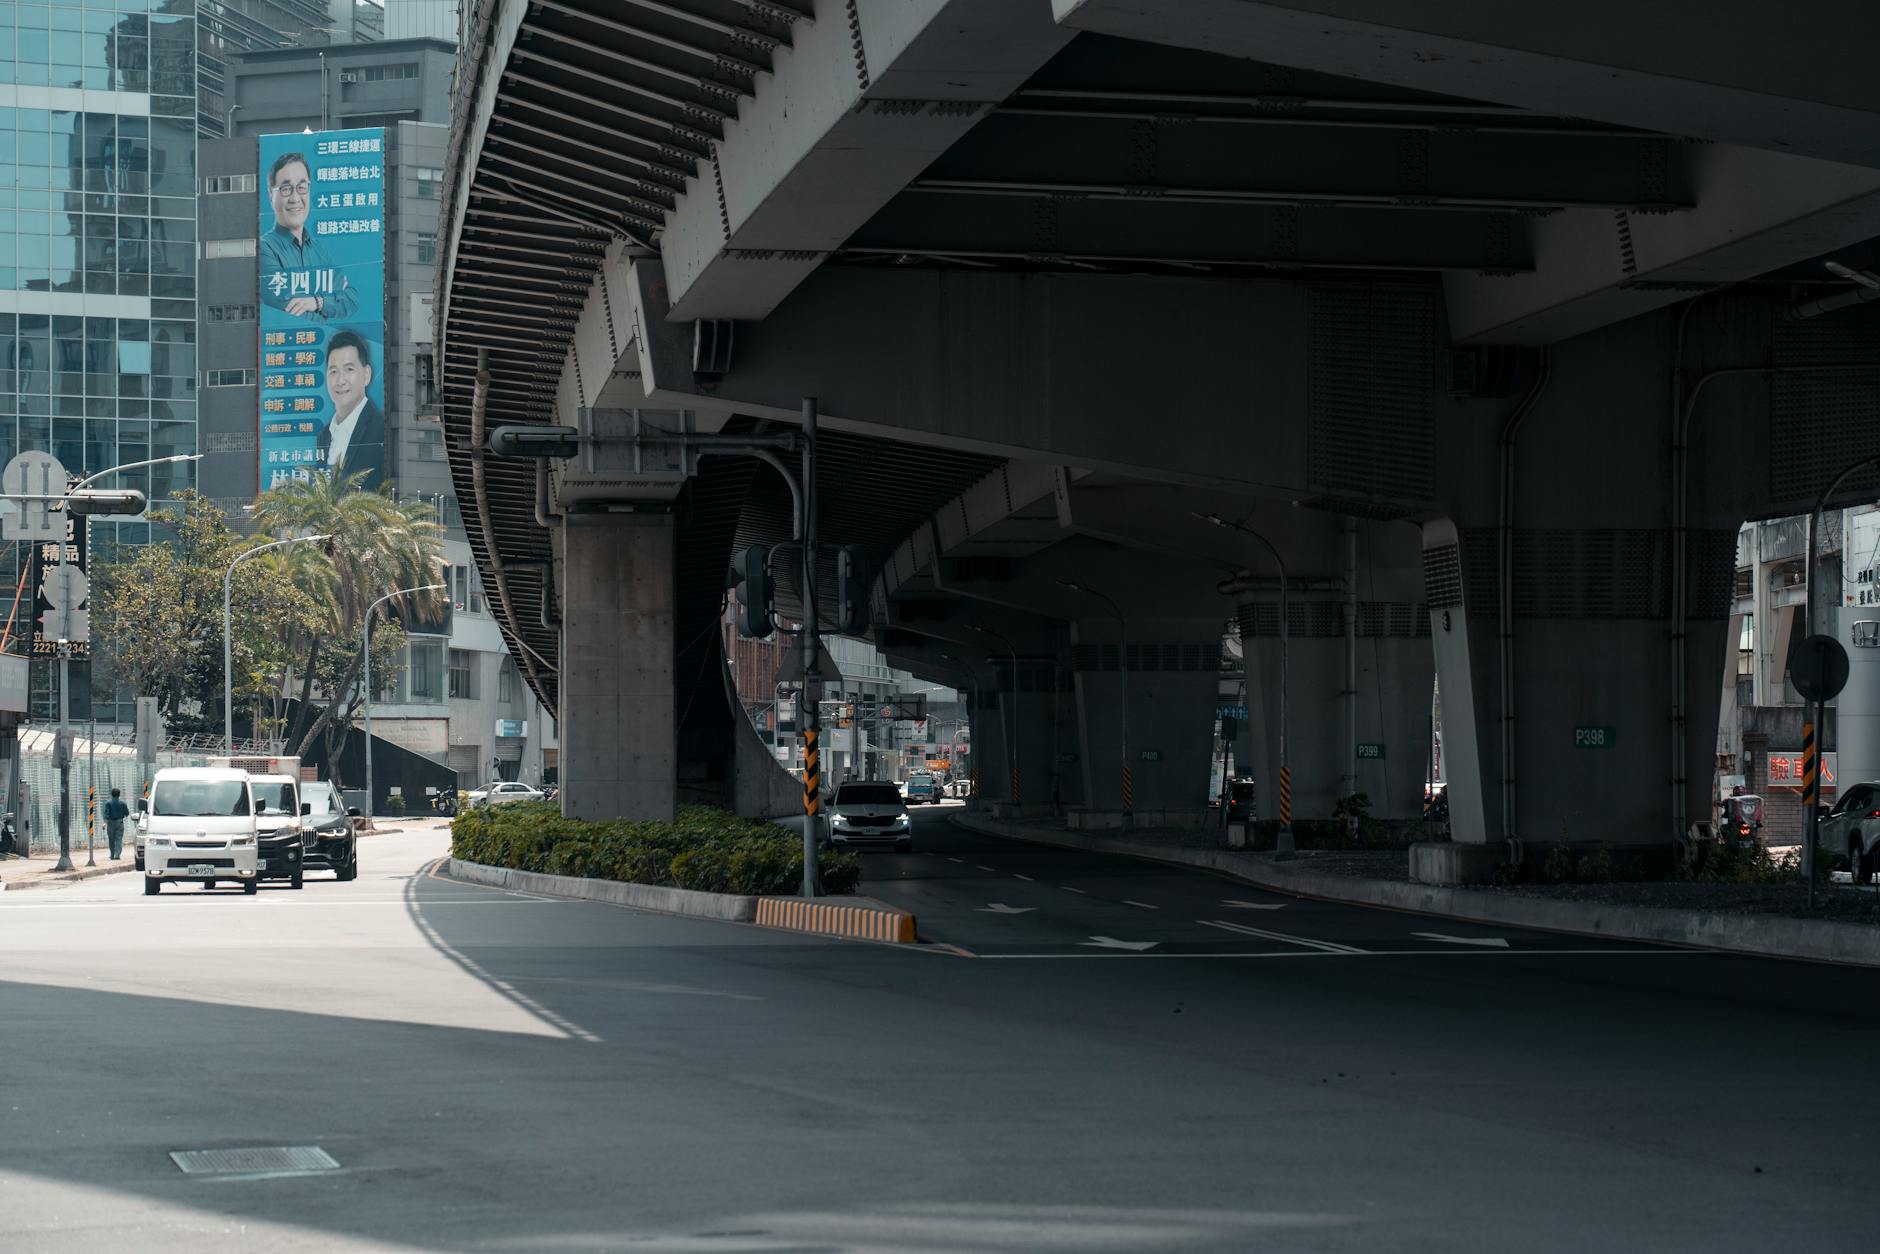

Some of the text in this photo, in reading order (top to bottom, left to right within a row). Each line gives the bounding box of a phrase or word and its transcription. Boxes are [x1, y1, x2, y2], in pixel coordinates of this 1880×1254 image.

[318, 139, 380, 154] 三環三線捷運
[317, 165, 380, 181] 輝達落地台北
[317, 219, 380, 235] 道路交通改善
[268, 269, 334, 297] 李四川
[268, 448, 325, 463] 新北市議員
[42, 544, 79, 562] 精品
[1576, 729, 1604, 744] P398
[1358, 745, 1378, 757] P399
